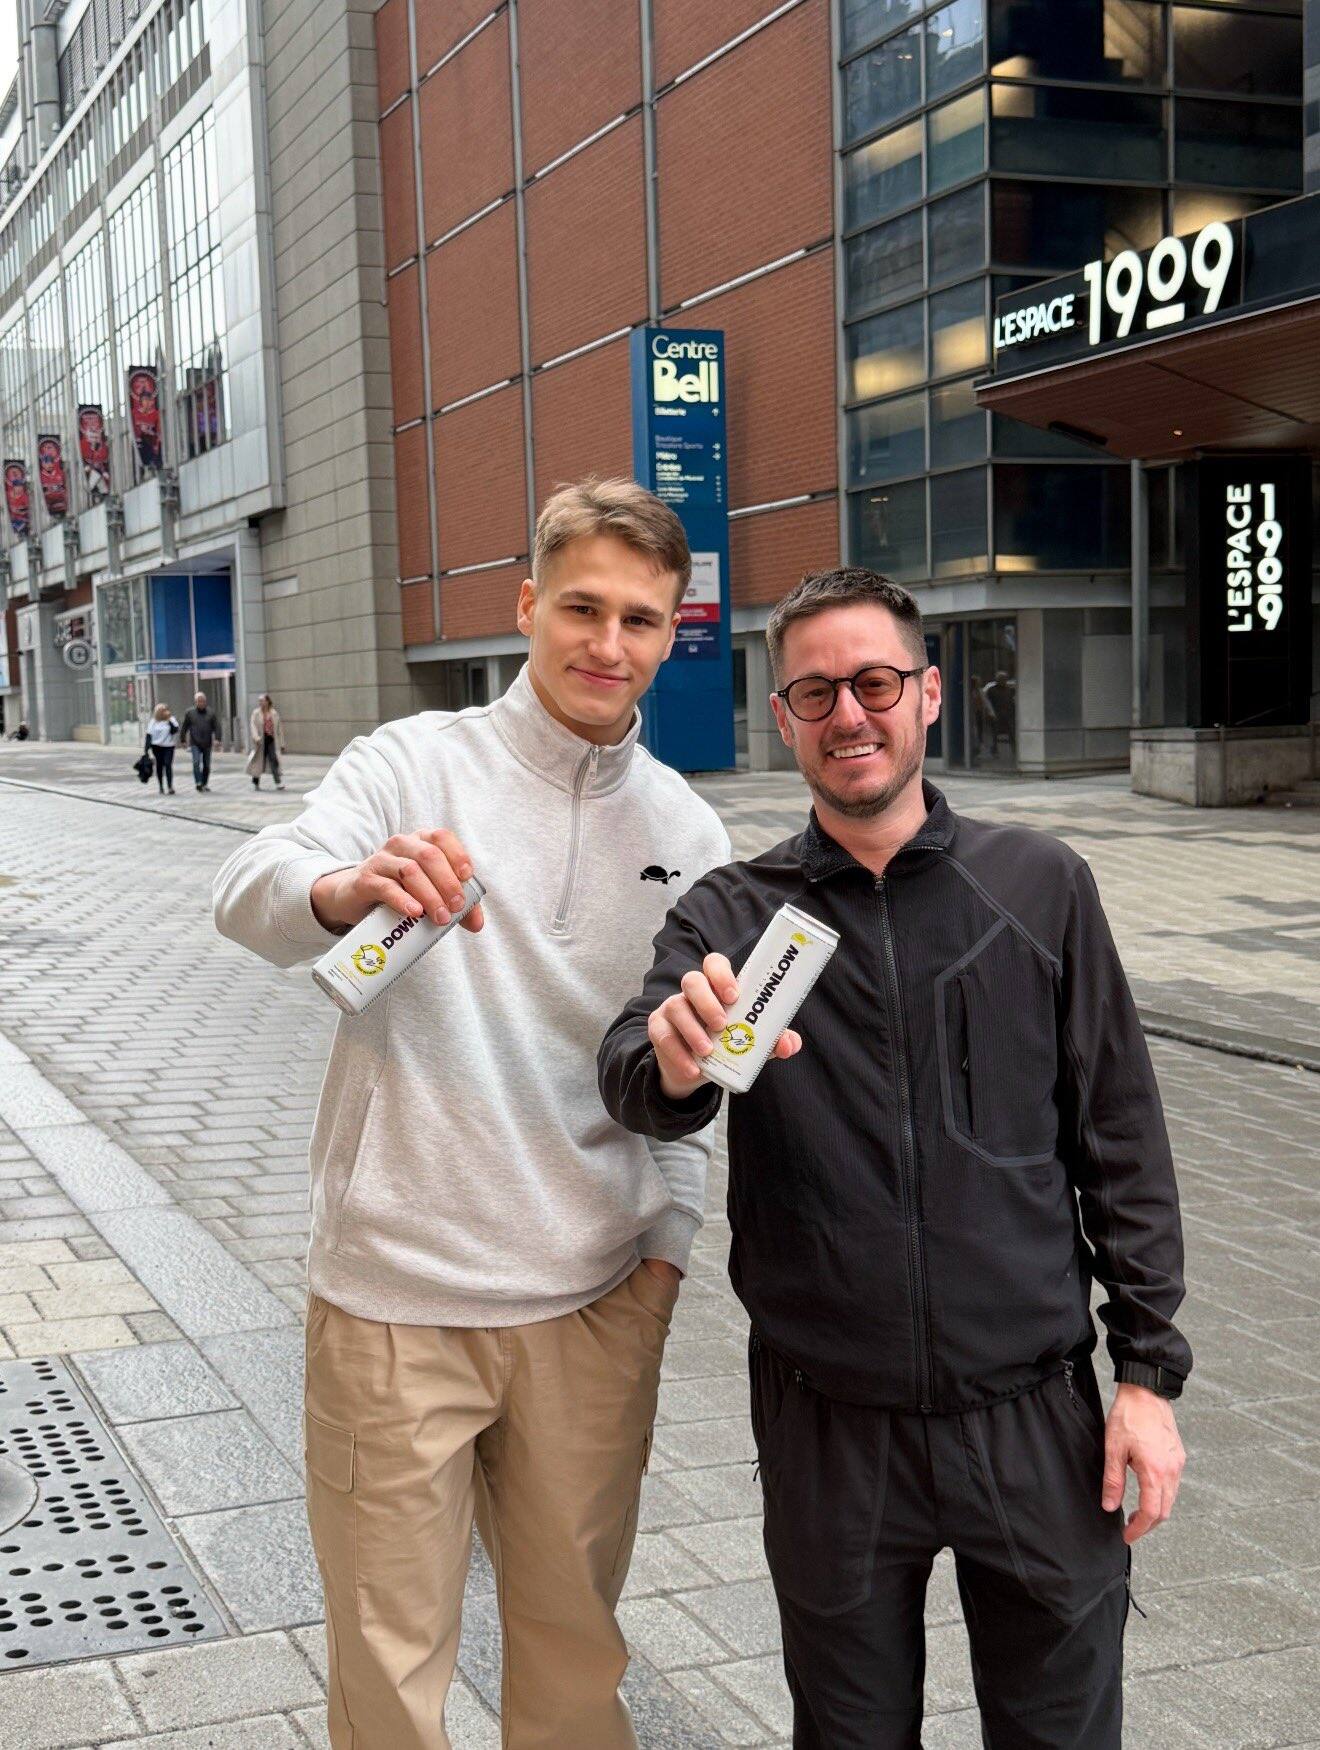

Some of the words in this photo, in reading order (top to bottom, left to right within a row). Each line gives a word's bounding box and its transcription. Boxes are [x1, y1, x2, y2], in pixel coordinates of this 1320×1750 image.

[994, 294, 1075, 348] L'ESPACE
[1084, 222, 1233, 345] 1909
[652, 335, 718, 359] Centre
[653, 360, 719, 403] Bell
[1226, 483, 1253, 632] L'ESPACE
[1257, 483, 1283, 630] 1909
[745, 944, 799, 1025] DOWNLOW
